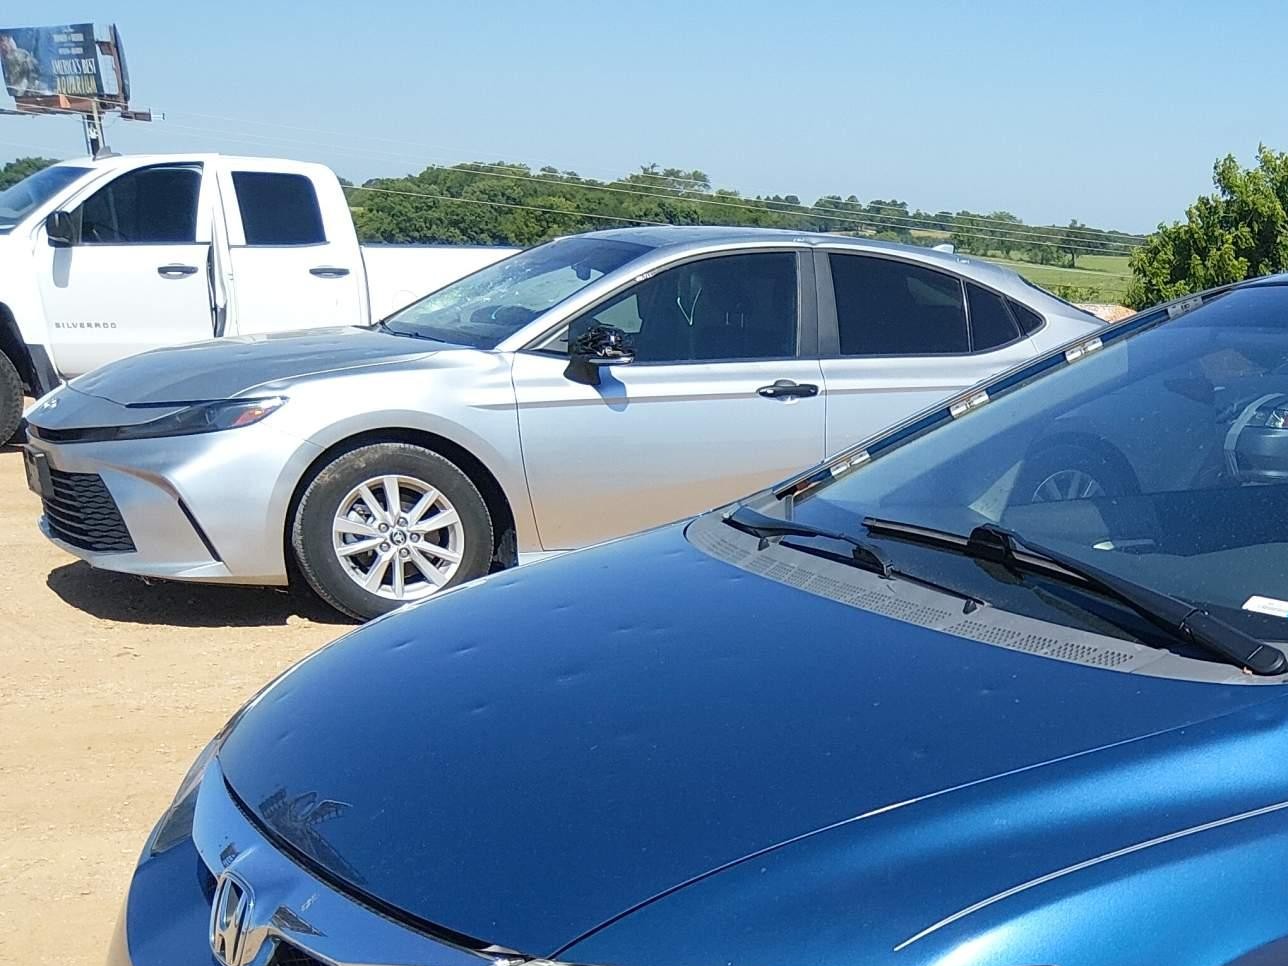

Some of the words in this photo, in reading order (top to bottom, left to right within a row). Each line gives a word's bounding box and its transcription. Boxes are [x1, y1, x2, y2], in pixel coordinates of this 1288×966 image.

[81, 57, 97, 74] BEST
[56, 74, 98, 95] AQUARIUM
[54, 321, 118, 329] SILVERADO
